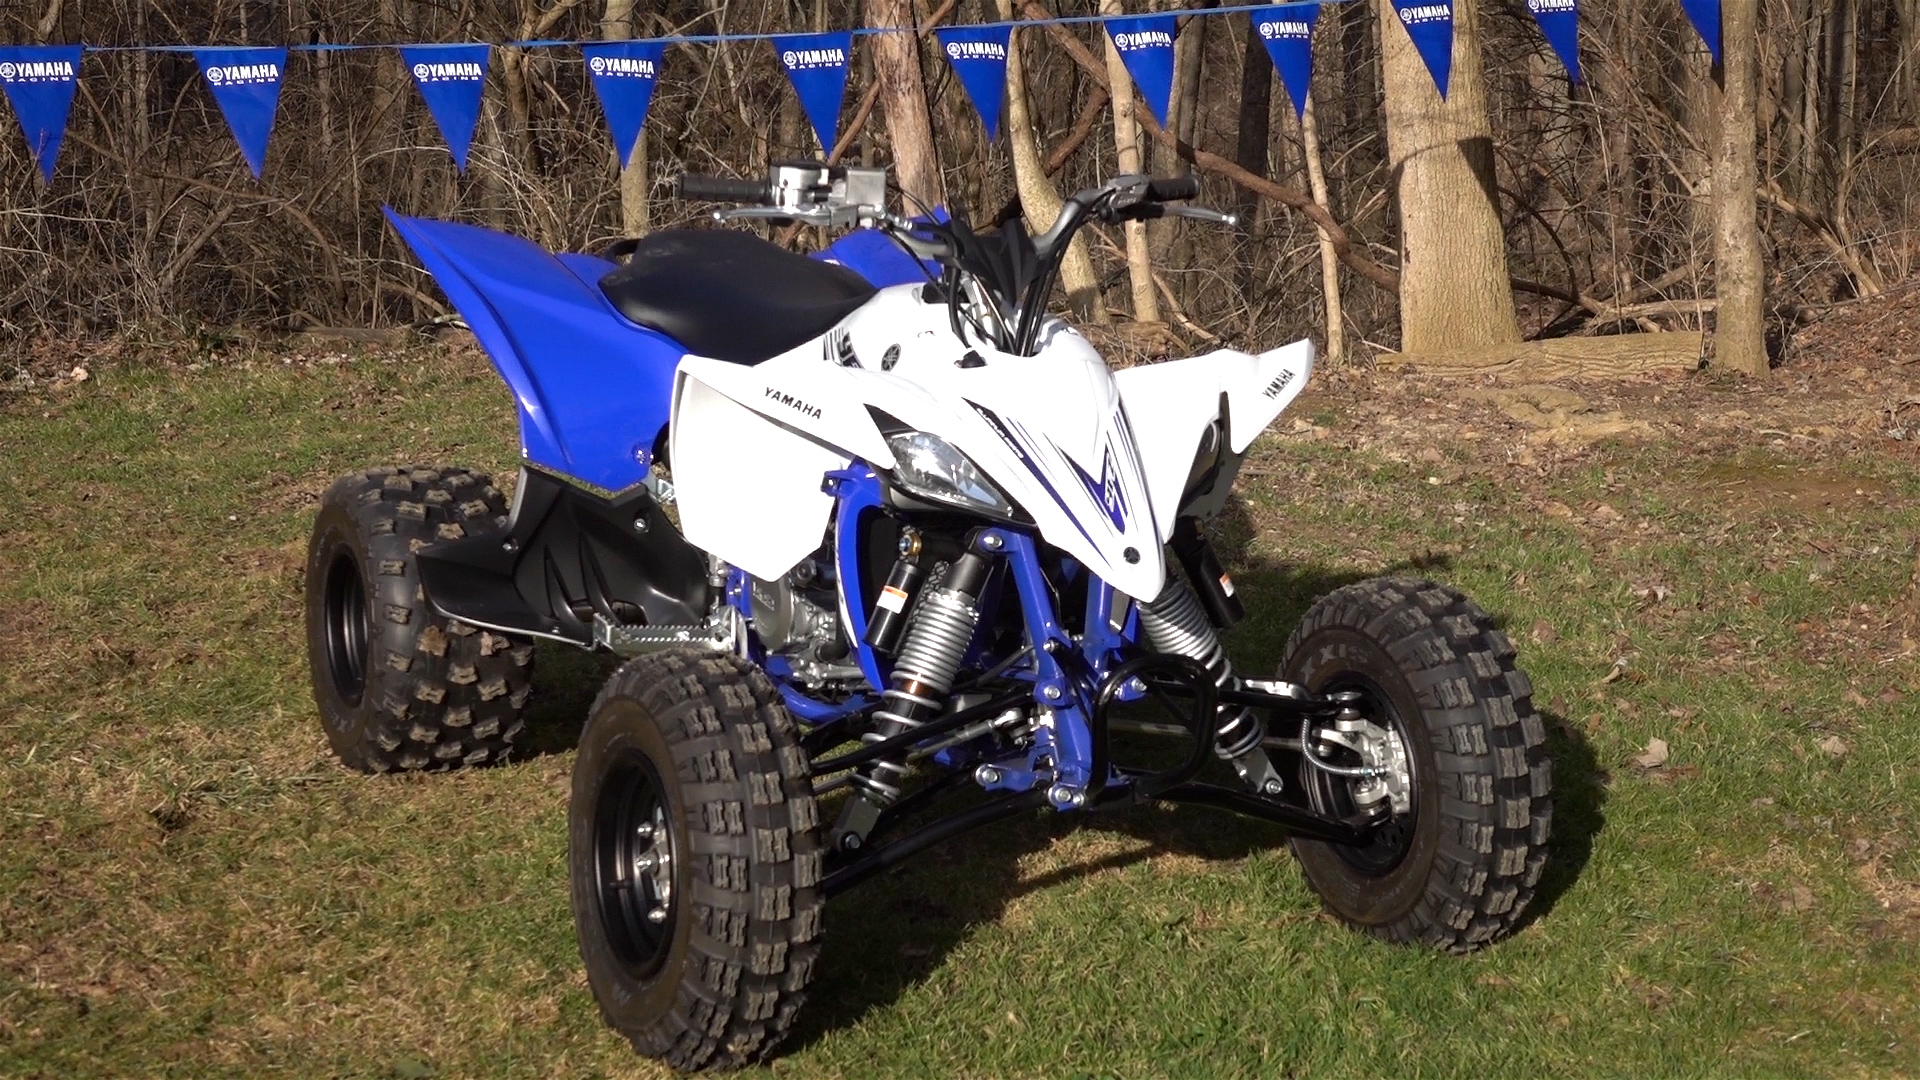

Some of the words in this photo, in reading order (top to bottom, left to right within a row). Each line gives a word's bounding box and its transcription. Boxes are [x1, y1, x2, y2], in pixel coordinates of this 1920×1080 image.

[1410, 4, 1451, 19] YAMAHA
[1271, 21, 1310, 35] YAMAHA
[1127, 31, 1172, 46] YAMAHA
[796, 48, 845, 64] YAMAHA
[960, 42, 1005, 56] YAMAHA
[15, 61, 74, 77] YAMAHA
[222, 64, 279, 80] YAMAHA
[428, 63, 482, 76] YAMAHA
[604, 58, 655, 75] YAMAHA
[1262, 368, 1296, 400] YAMAHA
[764, 386, 823, 420] YAMAHA
